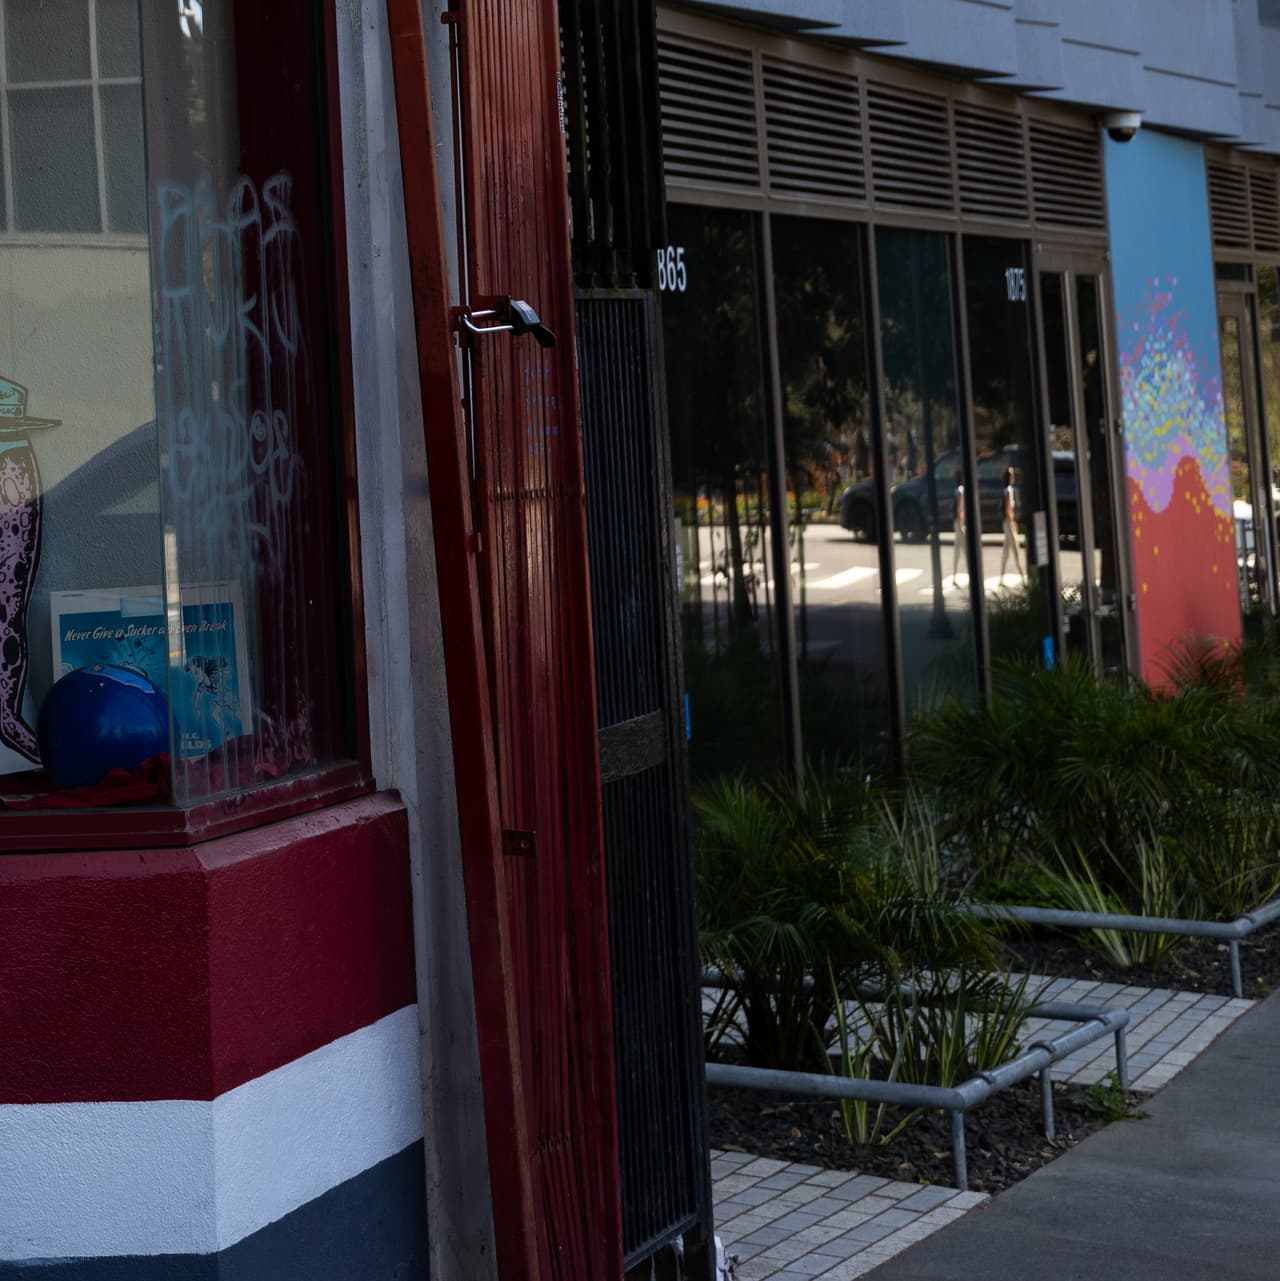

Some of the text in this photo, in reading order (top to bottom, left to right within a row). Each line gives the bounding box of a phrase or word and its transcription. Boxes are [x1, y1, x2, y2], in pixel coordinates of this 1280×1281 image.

[1004, 266, 1027, 302] 1875
[64, 628, 92, 642] Never
[92, 626, 113, 640] Give
[115, 628, 124, 639] a
[124, 623, 158, 638] Sucker
